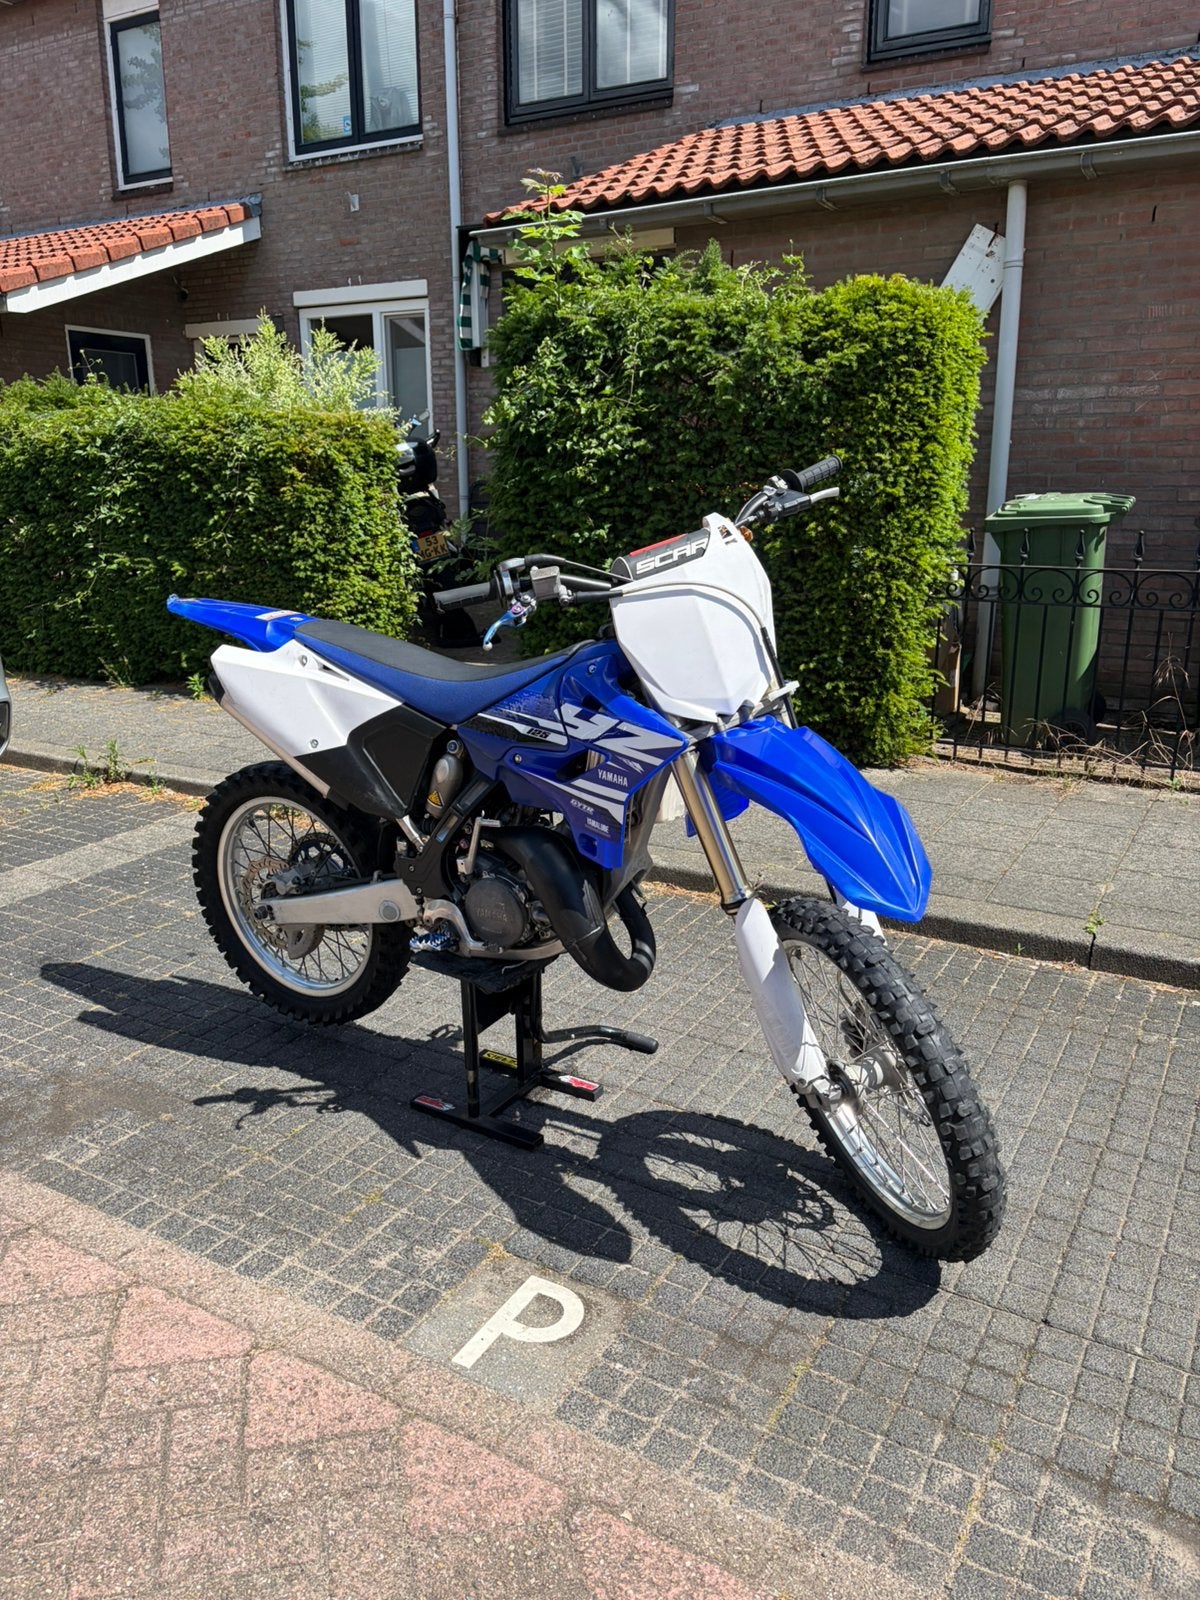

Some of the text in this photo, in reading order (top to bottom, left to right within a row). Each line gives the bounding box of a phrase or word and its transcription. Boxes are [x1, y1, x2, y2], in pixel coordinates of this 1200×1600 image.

[425, 535, 439, 547] 53
[636, 538, 709, 575] SCAR
[526, 727, 551, 739] 125
[597, 768, 629, 787] YAMAHA
[451, 1274, 585, 1369] P
